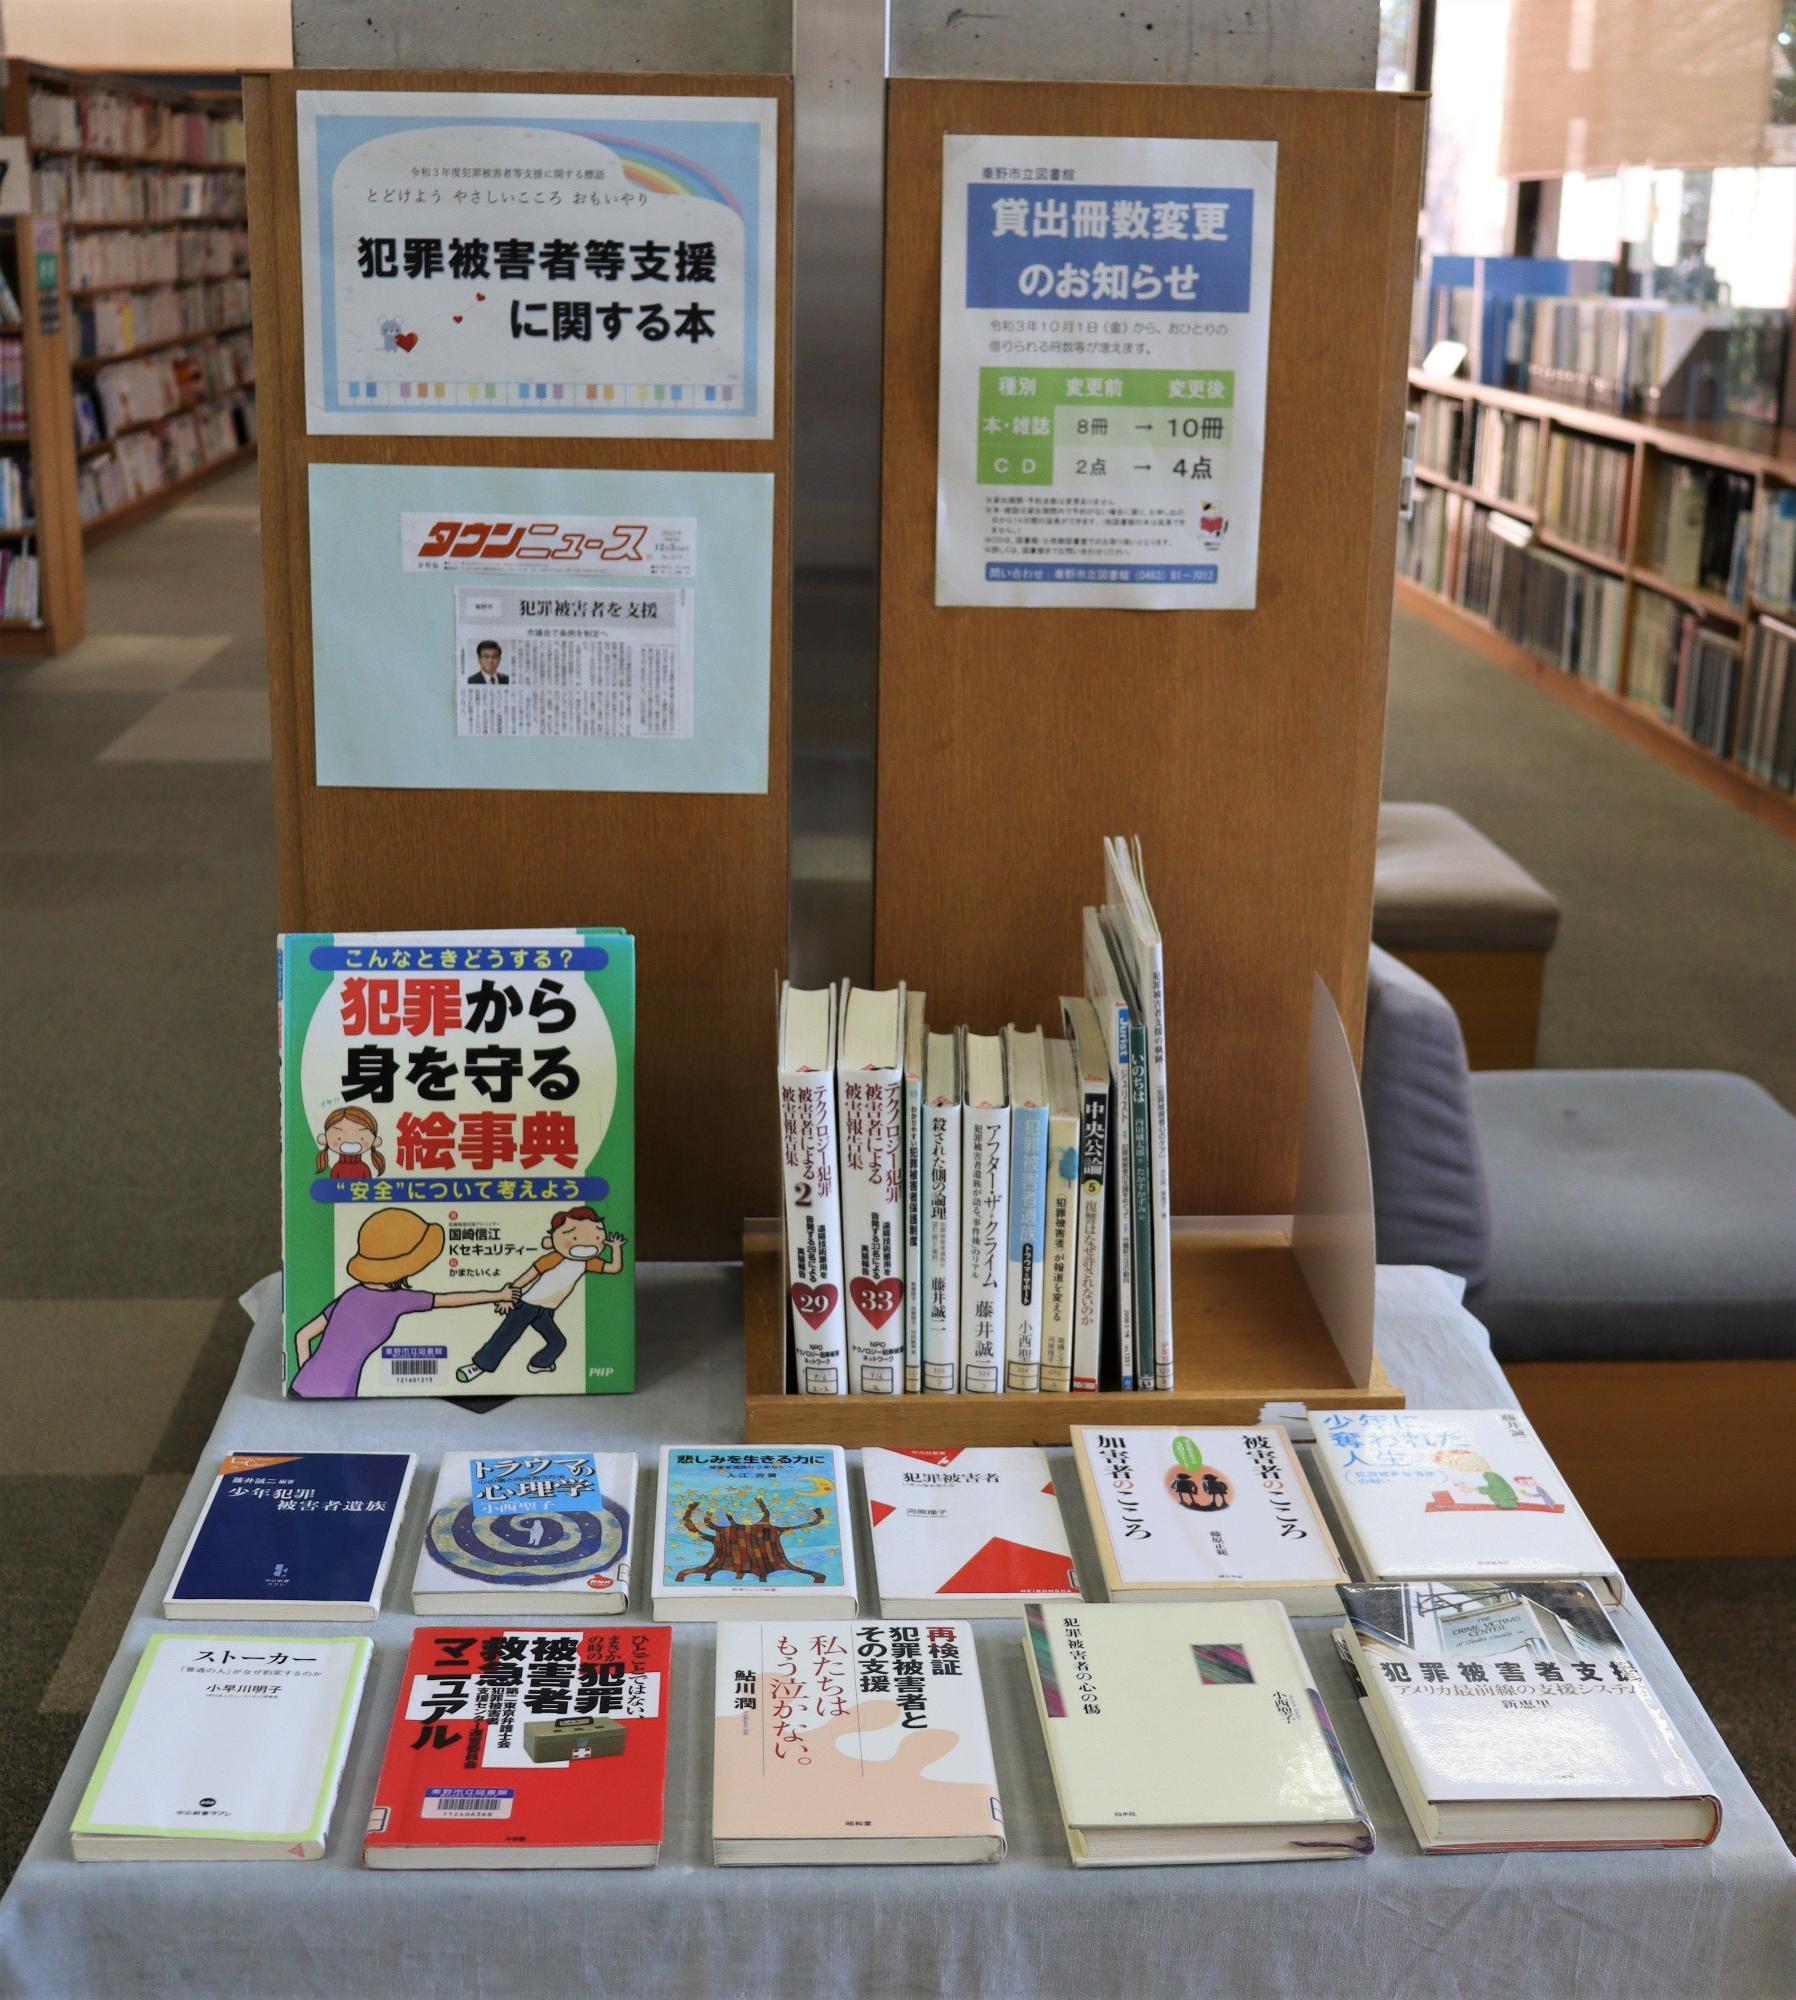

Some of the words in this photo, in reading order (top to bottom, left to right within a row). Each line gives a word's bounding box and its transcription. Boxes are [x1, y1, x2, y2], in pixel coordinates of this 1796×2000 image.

[982, 168, 1075, 182] 秦野市立図書館
[366, 187, 443, 204] とどけよう
[453, 188, 563, 205] やさしいこころ
[572, 190, 649, 207] おもいやり
[991, 198, 1230, 242] 貸出冊数変更
[357, 236, 718, 283] 犯罪被害者等支援
[1018, 262, 1200, 301] のお知らせ
[509, 299, 716, 344] に関する本
[998, 378, 1036, 396] 種別
[1065, 378, 1124, 398] 変更前
[1168, 379, 1226, 399] 変更後
[983, 416, 1050, 435] 本・雑誌
[1076, 418, 1109, 435] 8冊
[1167, 418, 1224, 440] 10冊
[1076, 458, 1107, 476] 2点
[1172, 456, 1213, 480] 4点
[418, 522, 648, 561] タウンニュース
[520, 599, 658, 620] 犯罪被害者を支援
[527, 628, 609, 638] 市議会で条例を制定へ
[340, 977, 577, 1037] 犯罪から
[341, 1044, 581, 1103] 身を守る
[396, 1111, 579, 1170] 絵事典
[782, 1086, 799, 1167] 被害報告集
[798, 1086, 816, 1180] 被害者による
[814, 1085, 832, 1198] テクノロジー犯罪
[845, 1082, 864, 1170] 被害報告集
[865, 1083, 883, 1185] 被害者による
[885, 1082, 902, 1203] テクノロジー犯罪
[1084, 1101, 1105, 1175] 中央公論
[931, 1117, 947, 1220] 殺された側の論理
[1088, 1182, 1096, 1192] 5
[794, 1182, 813, 1207] 2
[449, 1228, 501, 1241] 国崎信江
[449, 1243, 538, 1256] Kセキュリティー
[449, 1268, 501, 1277] かまたいくよ
[800, 1294, 830, 1313] 29
[861, 1290, 893, 1311] 33
[930, 1277, 947, 1331] 藤井誠二
[975, 1300, 994, 1363] 藤井誠
[590, 1367, 615, 1377] PHP
[1323, 1413, 1419, 1430] 少年に
[1329, 1431, 1472, 1449] 奪われた
[475, 1457, 595, 1479] トラウマの
[676, 1454, 825, 1465] 悲しみを生きる力に
[903, 1472, 1000, 1483] 犯罪被害者
[1342, 1450, 1411, 1468] 人生
[227, 1487, 316, 1500] 少年犯罪
[276, 1500, 388, 1512] 被害者遺族
[475, 1478, 593, 1501] 心理学
[1097, 1434, 1152, 1540] 加害者のこころ
[1242, 1434, 1308, 1540] 被害者のこころ
[605, 1635, 622, 1660] まさか
[1468, 1625, 1506, 1637] CENTER
[194, 1650, 318, 1665] ストーカー
[475, 1636, 529, 1686] 救急
[856, 1626, 891, 1692] その支援
[926, 1626, 962, 1676] 再検証
[1063, 1617, 1101, 1715] 犯罪被害者の心の傷
[206, 1684, 283, 1694] 小早川明子
[411, 1637, 479, 1751] マニュアル
[523, 1637, 579, 1714] 被害者
[574, 1662, 626, 1714] 犯罪
[733, 1669, 756, 1710] 鮎川潤
[809, 1635, 851, 1717] 私たちは
[889, 1626, 928, 1729] 犯罪被害者と
[486, 1687, 505, 1726] 犯罪被害者
[497, 1687, 519, 1749] 第二東京弁護士会
[770, 1635, 812, 1766] もう泣かない。
[1501, 1698, 1552, 1710] 新恵里
